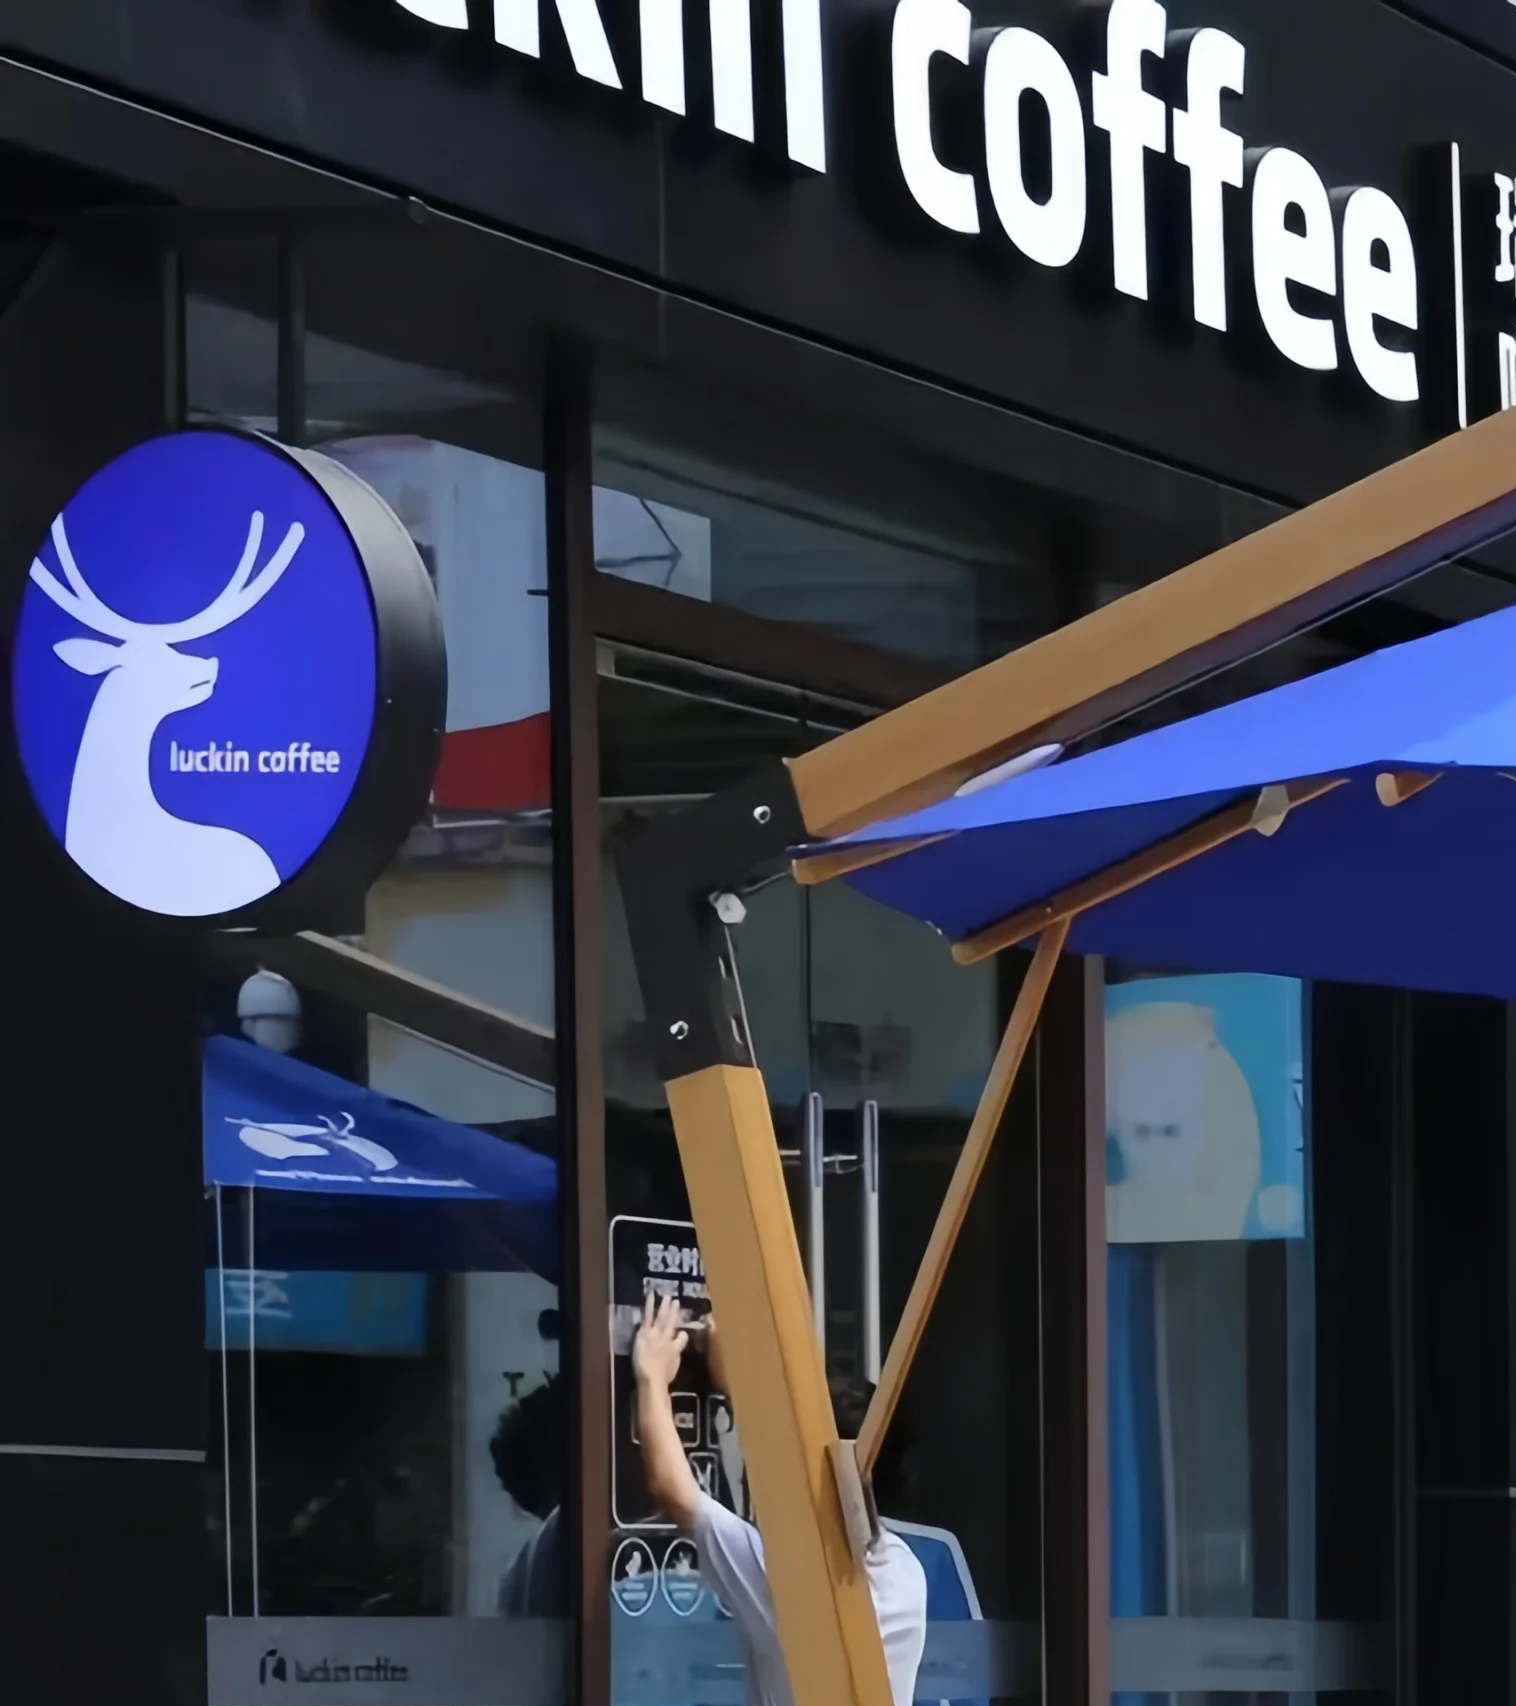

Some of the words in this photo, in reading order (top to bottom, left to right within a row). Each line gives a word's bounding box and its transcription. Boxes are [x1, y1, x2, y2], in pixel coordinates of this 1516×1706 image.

[890, 0, 1420, 402] coffee
[169, 740, 250, 773] luckin
[257, 742, 340, 773] coffee
